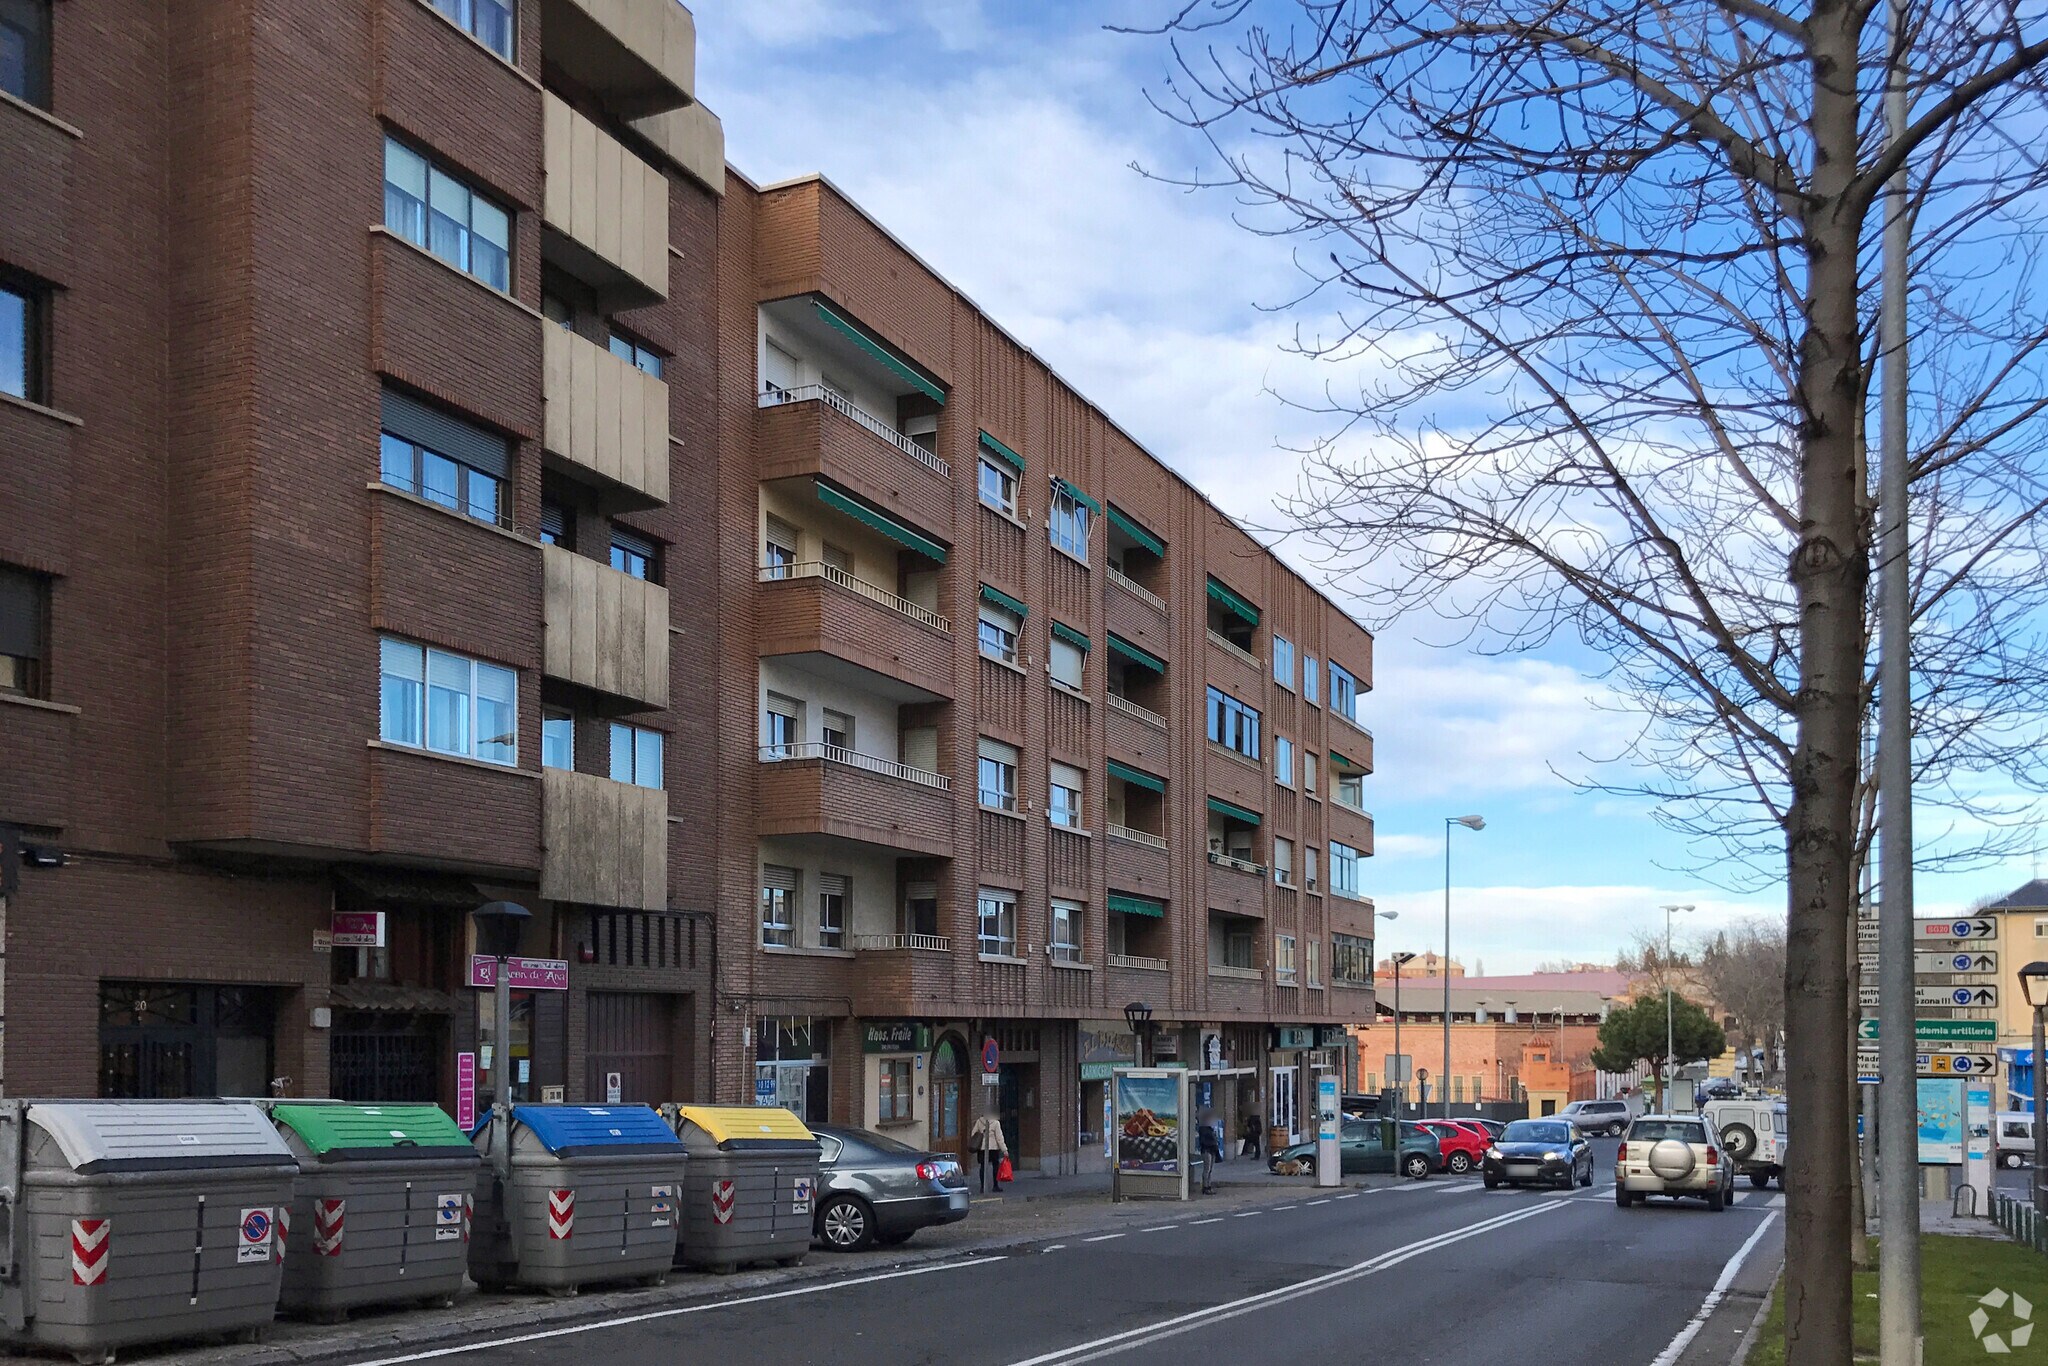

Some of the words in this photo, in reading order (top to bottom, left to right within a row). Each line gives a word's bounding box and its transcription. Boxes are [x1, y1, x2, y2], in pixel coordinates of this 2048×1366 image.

[1927, 925, 1949, 933] SG20
[544, 971, 566, 985] Ana
[135, 1000, 147, 1011] 20
[891, 1026, 912, 1041] Fraile
[1916, 1027, 1949, 1036] ademia
[1857, 1054, 1880, 1063] Madr
